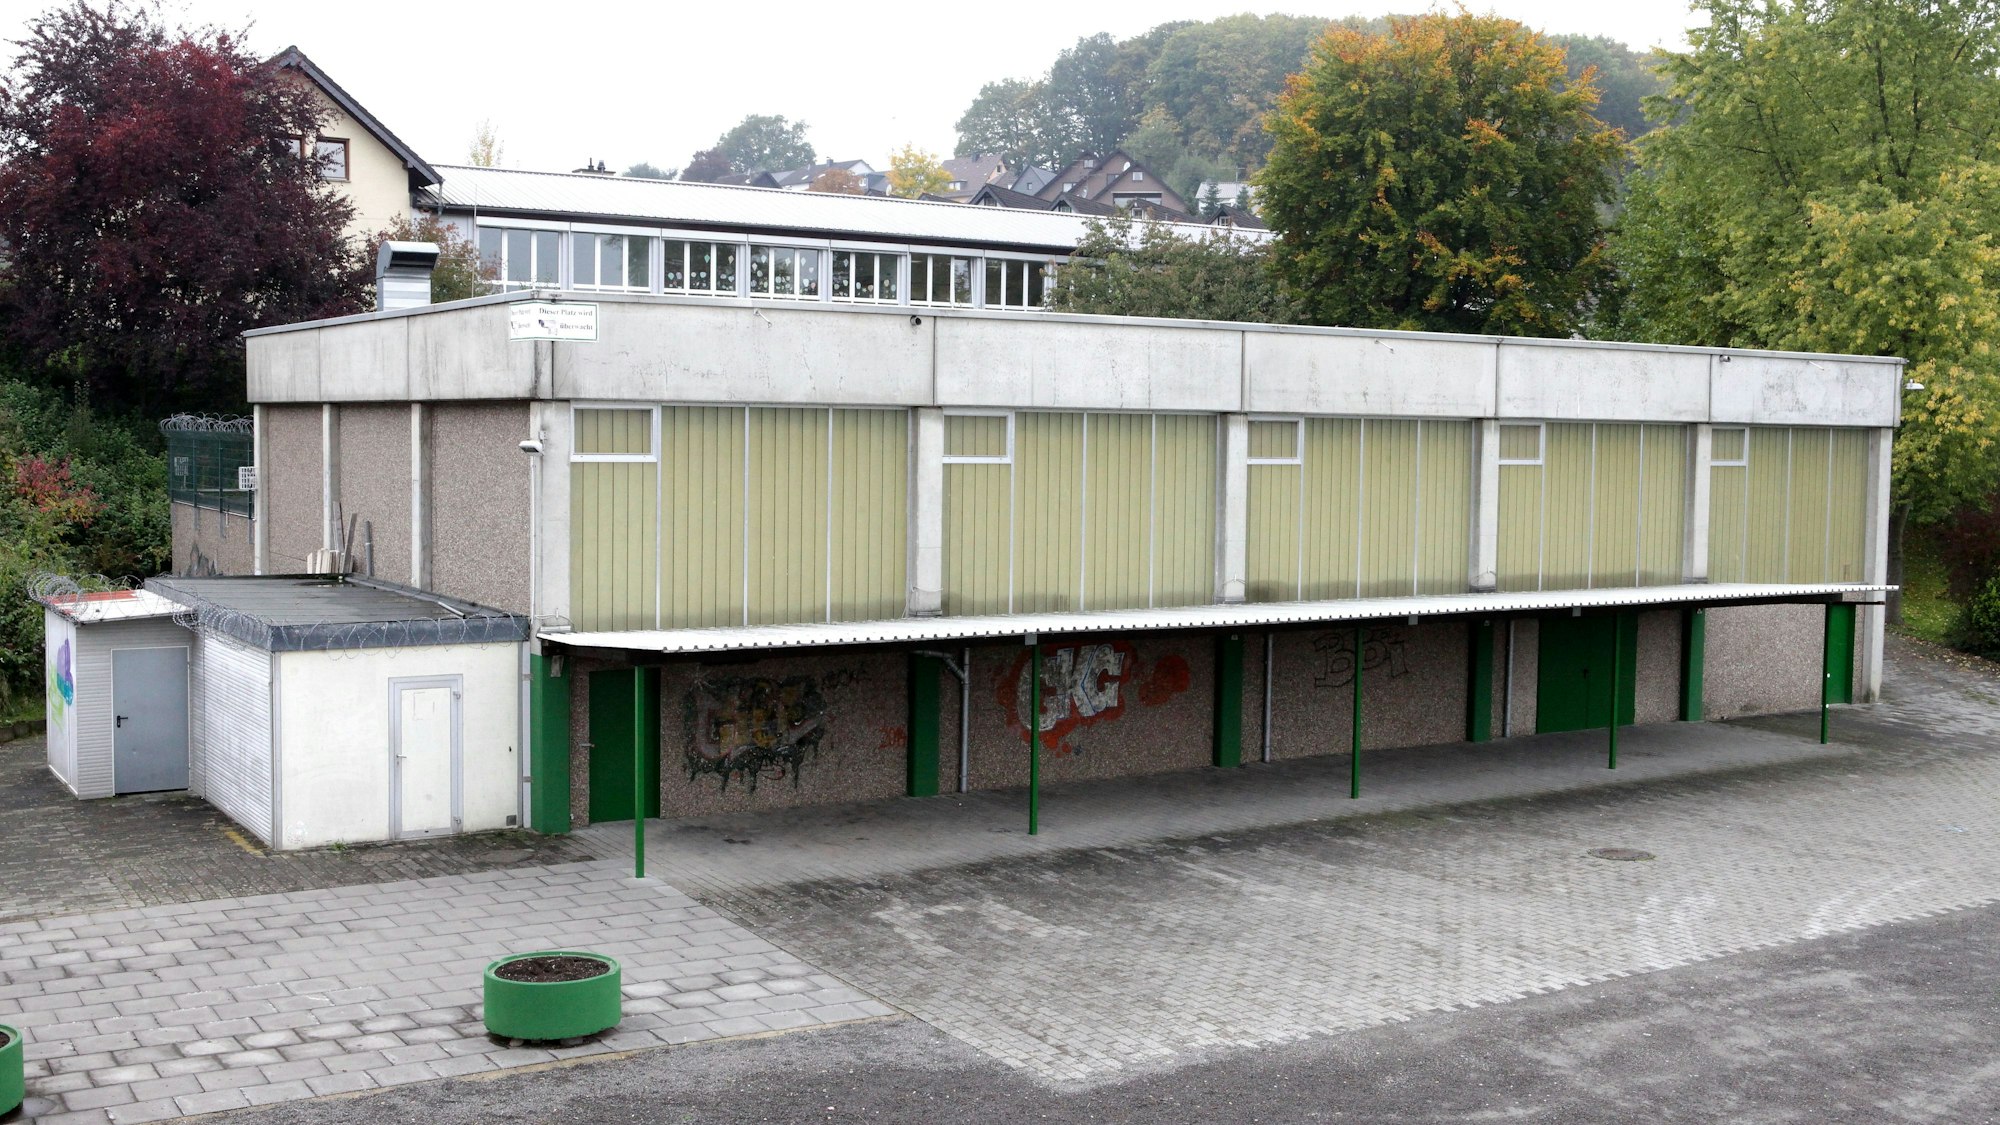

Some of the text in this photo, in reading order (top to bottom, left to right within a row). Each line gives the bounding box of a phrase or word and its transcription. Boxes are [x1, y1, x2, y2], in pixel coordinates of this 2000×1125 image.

[539, 307, 560, 315] Dieser
[561, 309, 576, 317] Platz
[560, 322, 593, 331] überwacht
